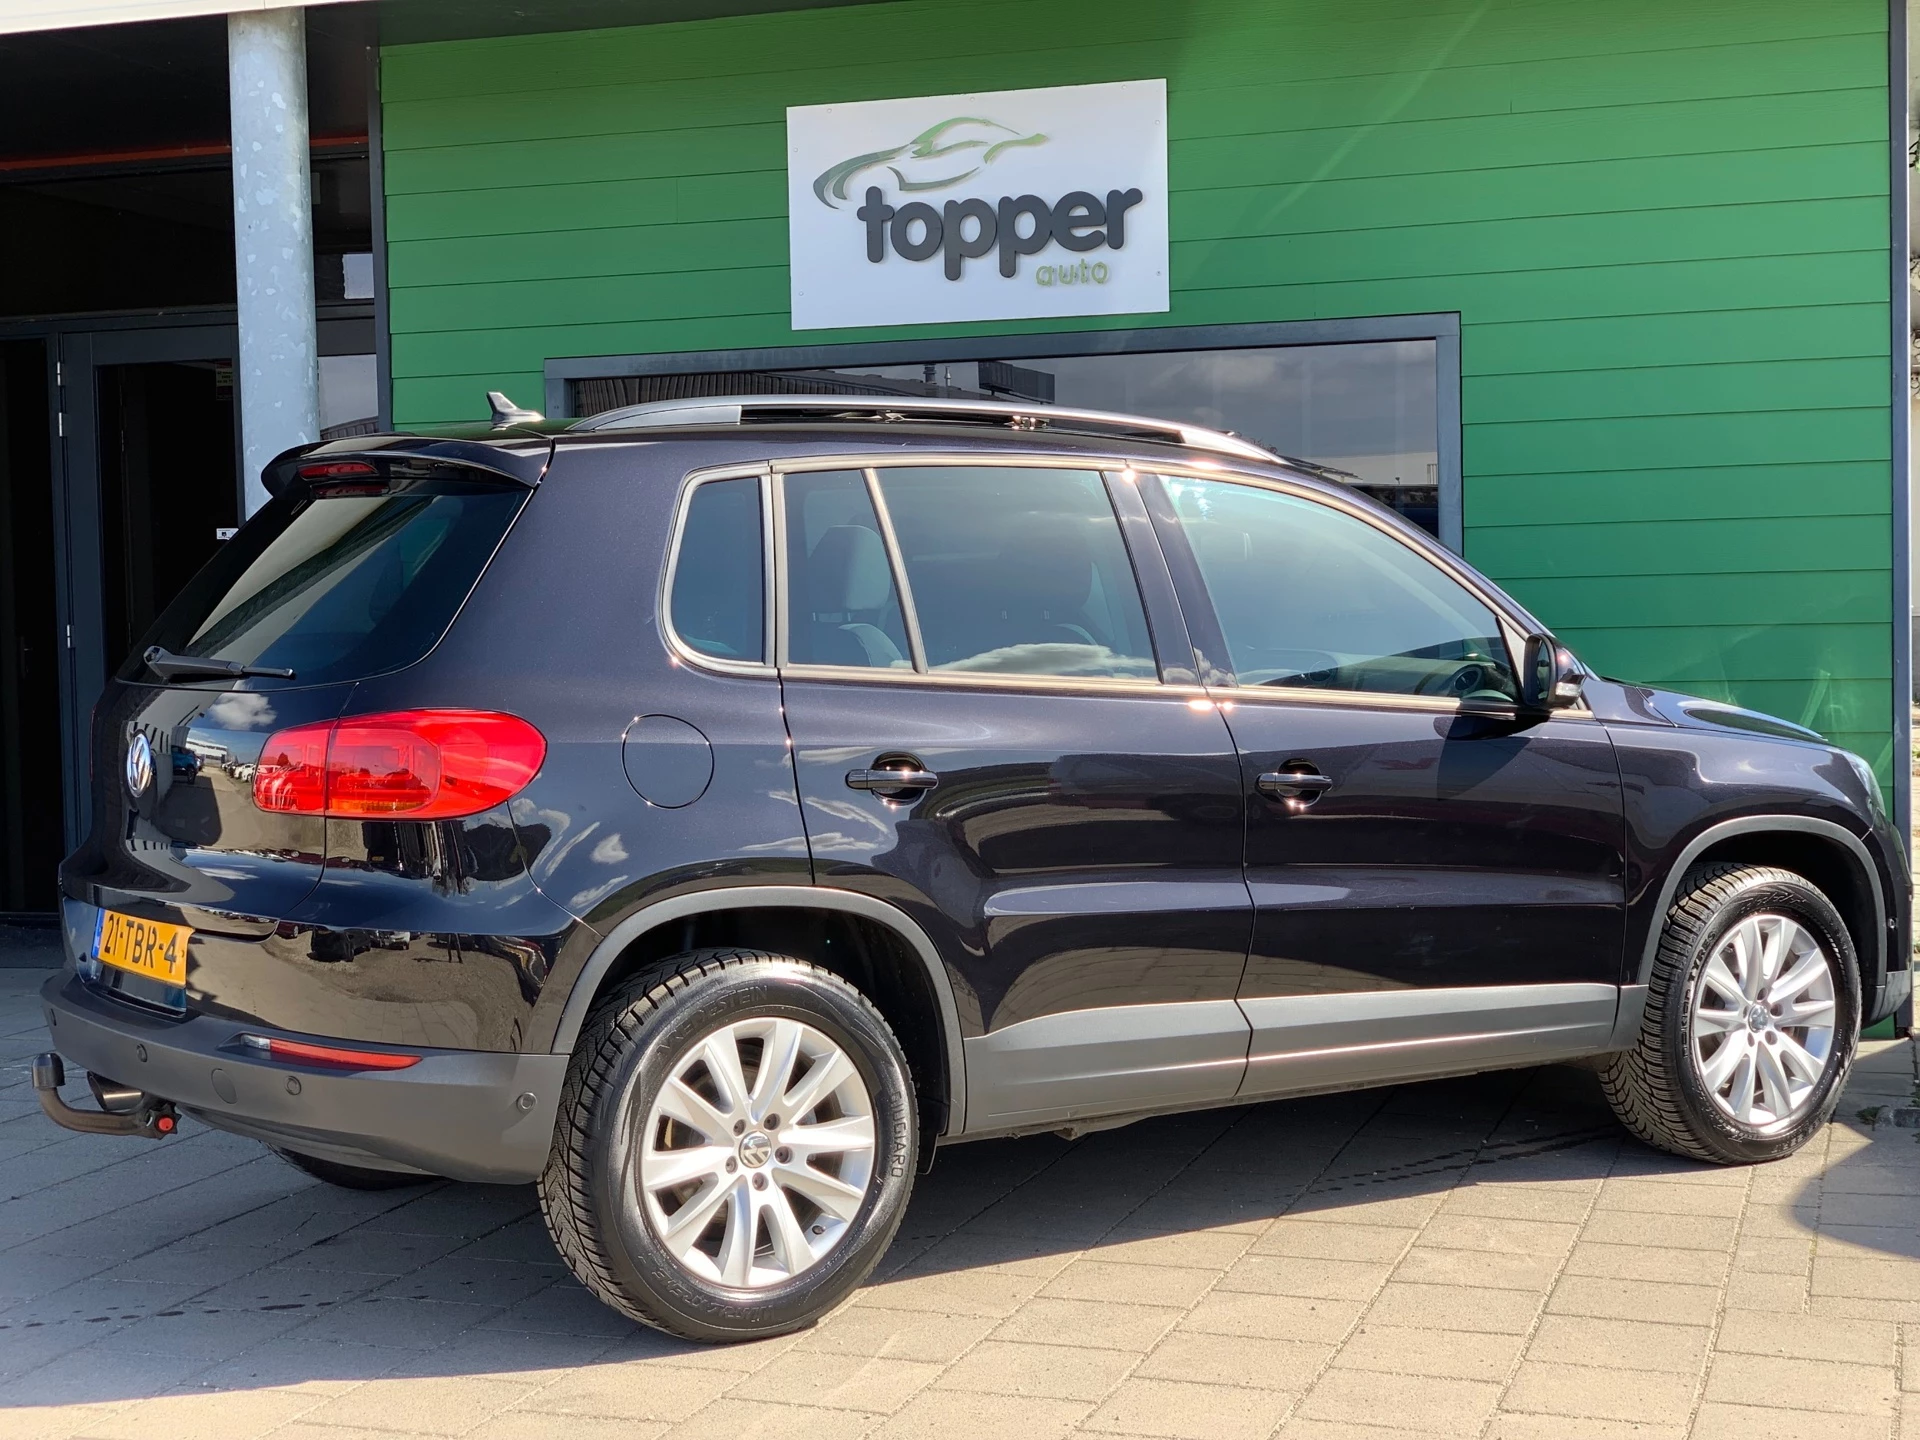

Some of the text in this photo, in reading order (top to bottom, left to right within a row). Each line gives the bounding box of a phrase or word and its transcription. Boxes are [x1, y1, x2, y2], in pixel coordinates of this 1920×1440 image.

[857, 186, 1143, 281] topper
[1035, 258, 1108, 287] auto
[104, 913, 178, 974] 21-TBR-4
[1688, 931, 1716, 982] TYRES
[890, 1091, 907, 1178] GIUGIARO
